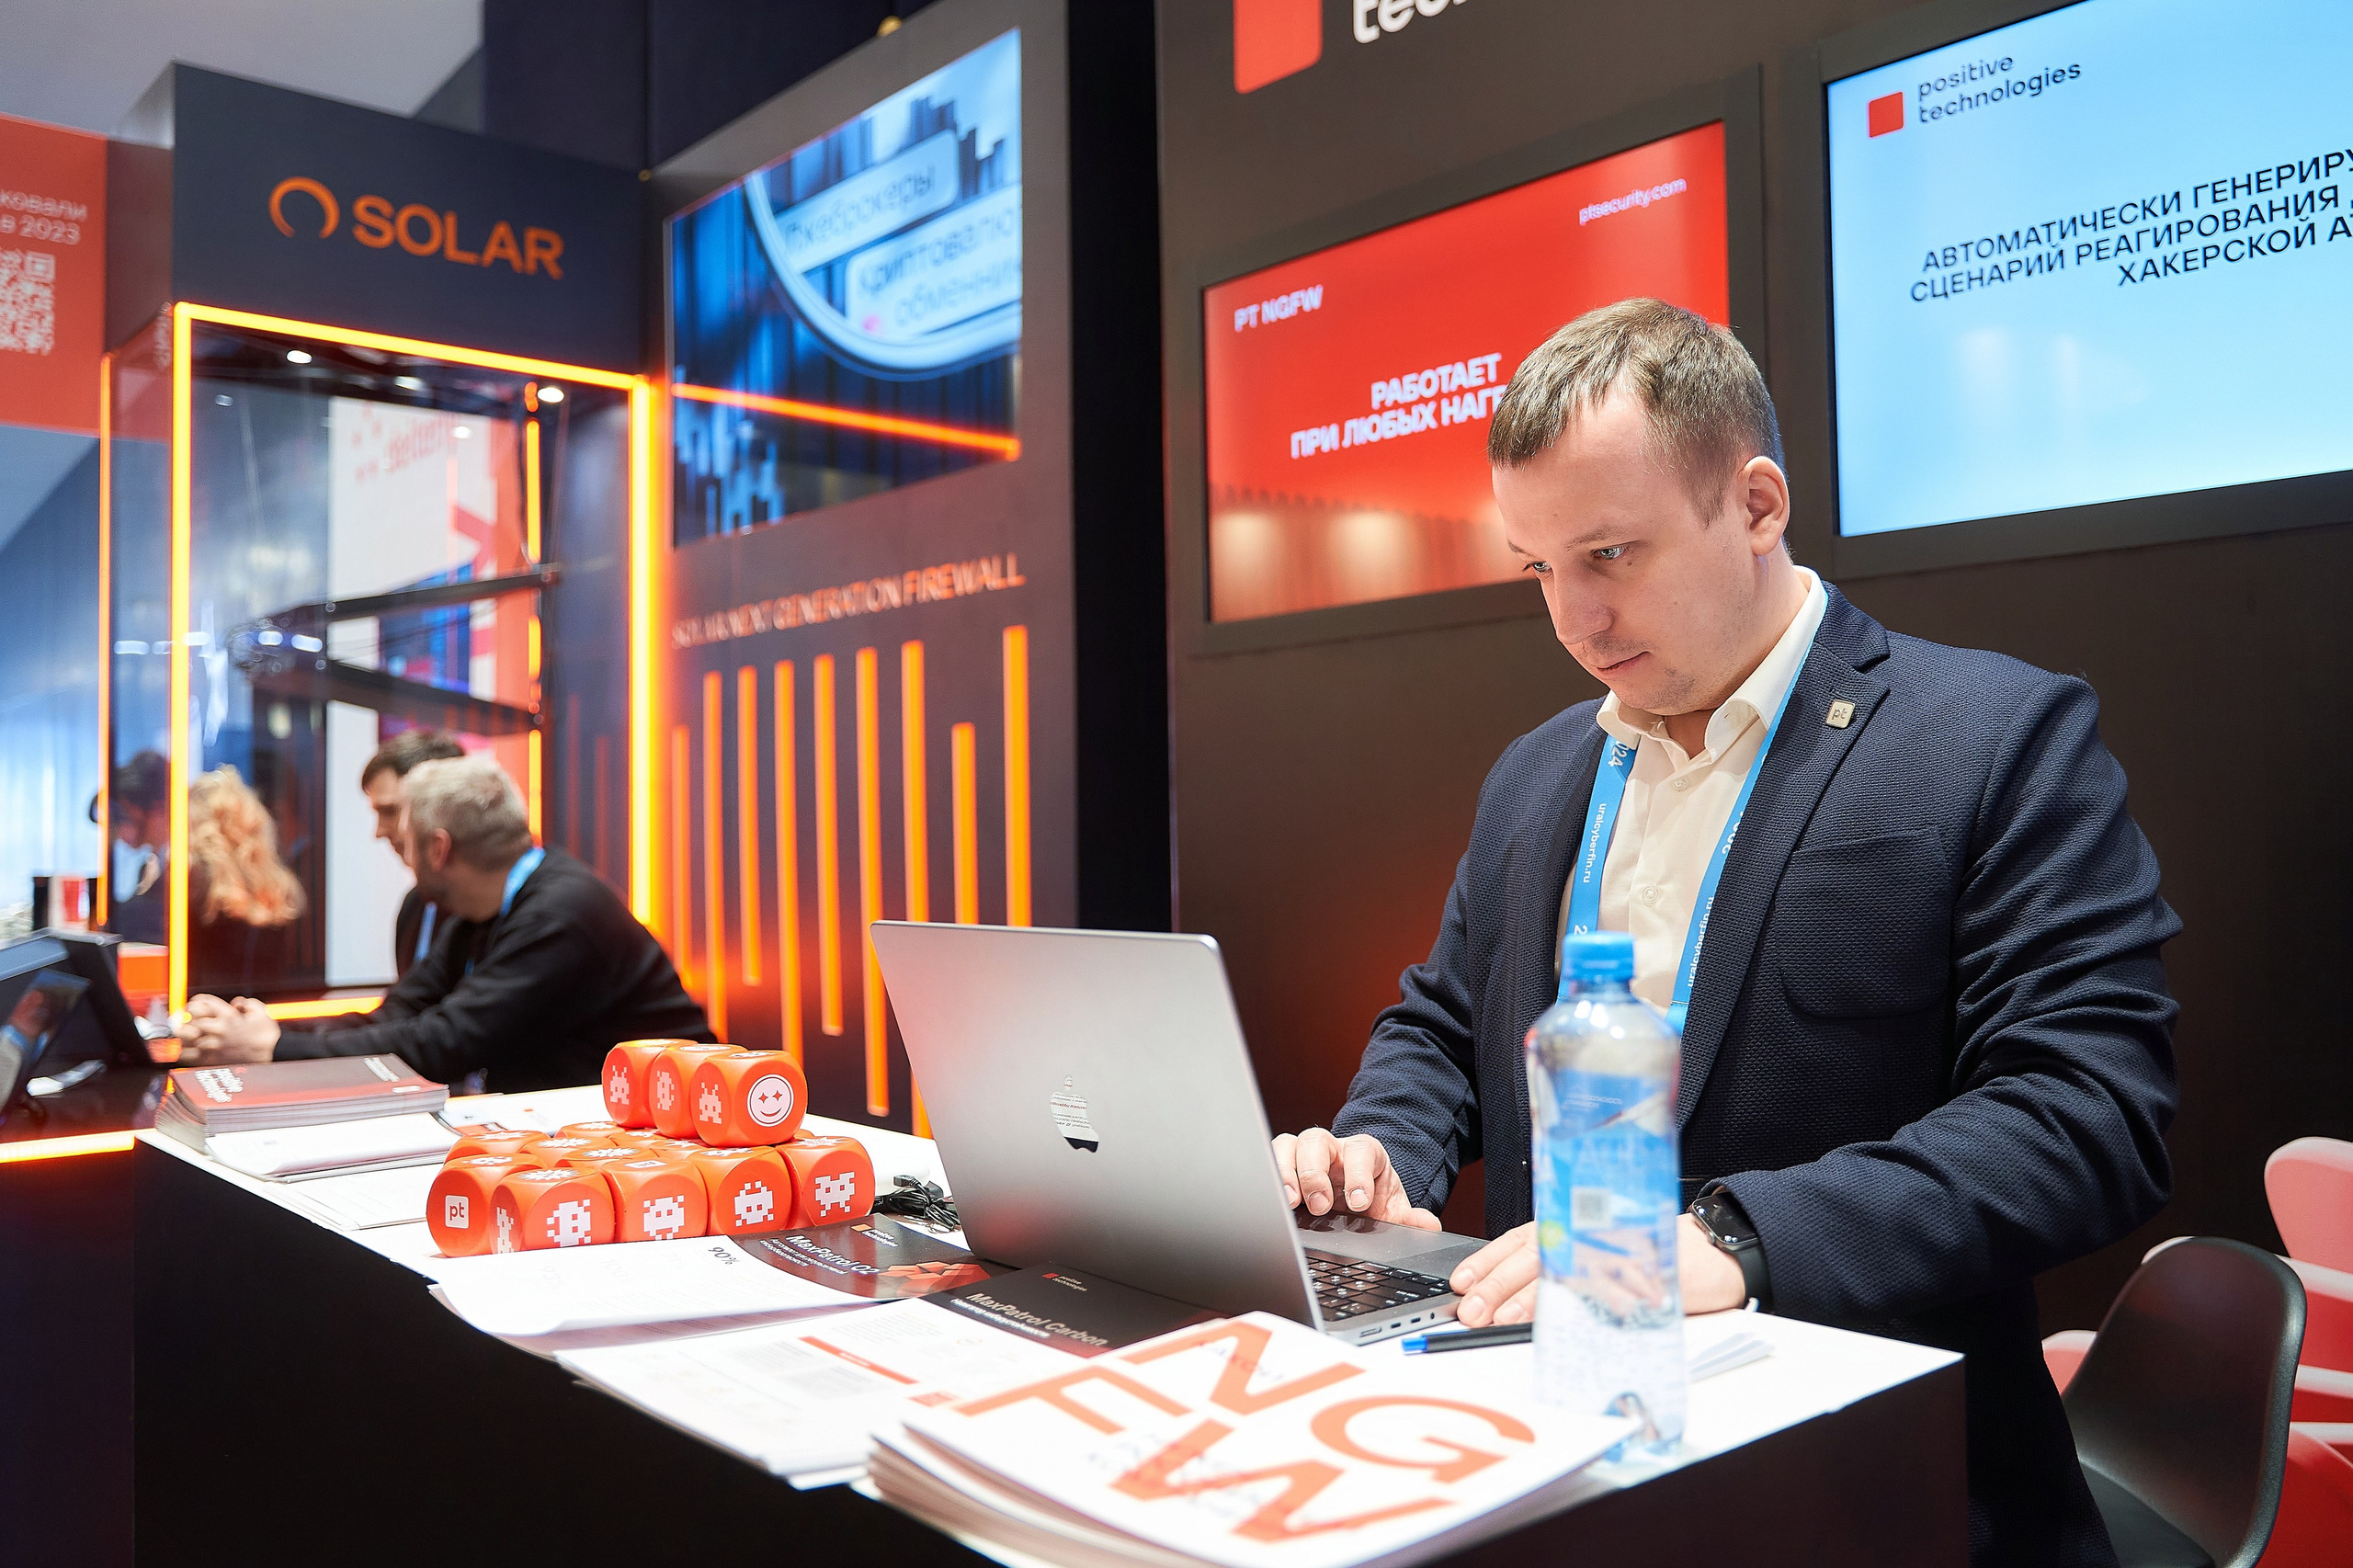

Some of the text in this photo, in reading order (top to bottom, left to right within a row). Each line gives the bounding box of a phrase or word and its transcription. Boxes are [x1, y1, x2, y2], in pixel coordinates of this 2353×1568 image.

[1917, 56, 2014, 102] positive
[1918, 62, 2082, 123] technologies
[18, 214, 81, 245] 2023
[1579, 178, 1687, 226] ptsecurity.com
[352, 194, 564, 280] SOLAR
[1910, 185, 2339, 301] СЦЕНАРИЙ РЕАГИРОВАНИЯ
[1923, 190, 2181, 272] АВТОМАТИЧЕСКИ
[2118, 216, 2316, 287] ХАКЕРСКОЙ
[1233, 284, 1324, 333] PT NGFW
[1370, 352, 1502, 409] РАБОТАЕТ
[1290, 423, 1339, 460] ПРИ
[1342, 400, 1438, 448] ЛЮБЫХ
[773, 574, 903, 631] GENERATION
[903, 552, 1028, 606] FIREWALL
[1831, 708, 1847, 721] pt
[1583, 802, 1607, 883] uralcyberfin.ru
[449, 1202, 465, 1221] pt
[707, 1246, 741, 1266] 90%
[786, 1235, 860, 1267] MaxPatrol
[966, 1292, 1047, 1326] MaxPatrol
[1044, 1322, 1108, 1346] Carbon
